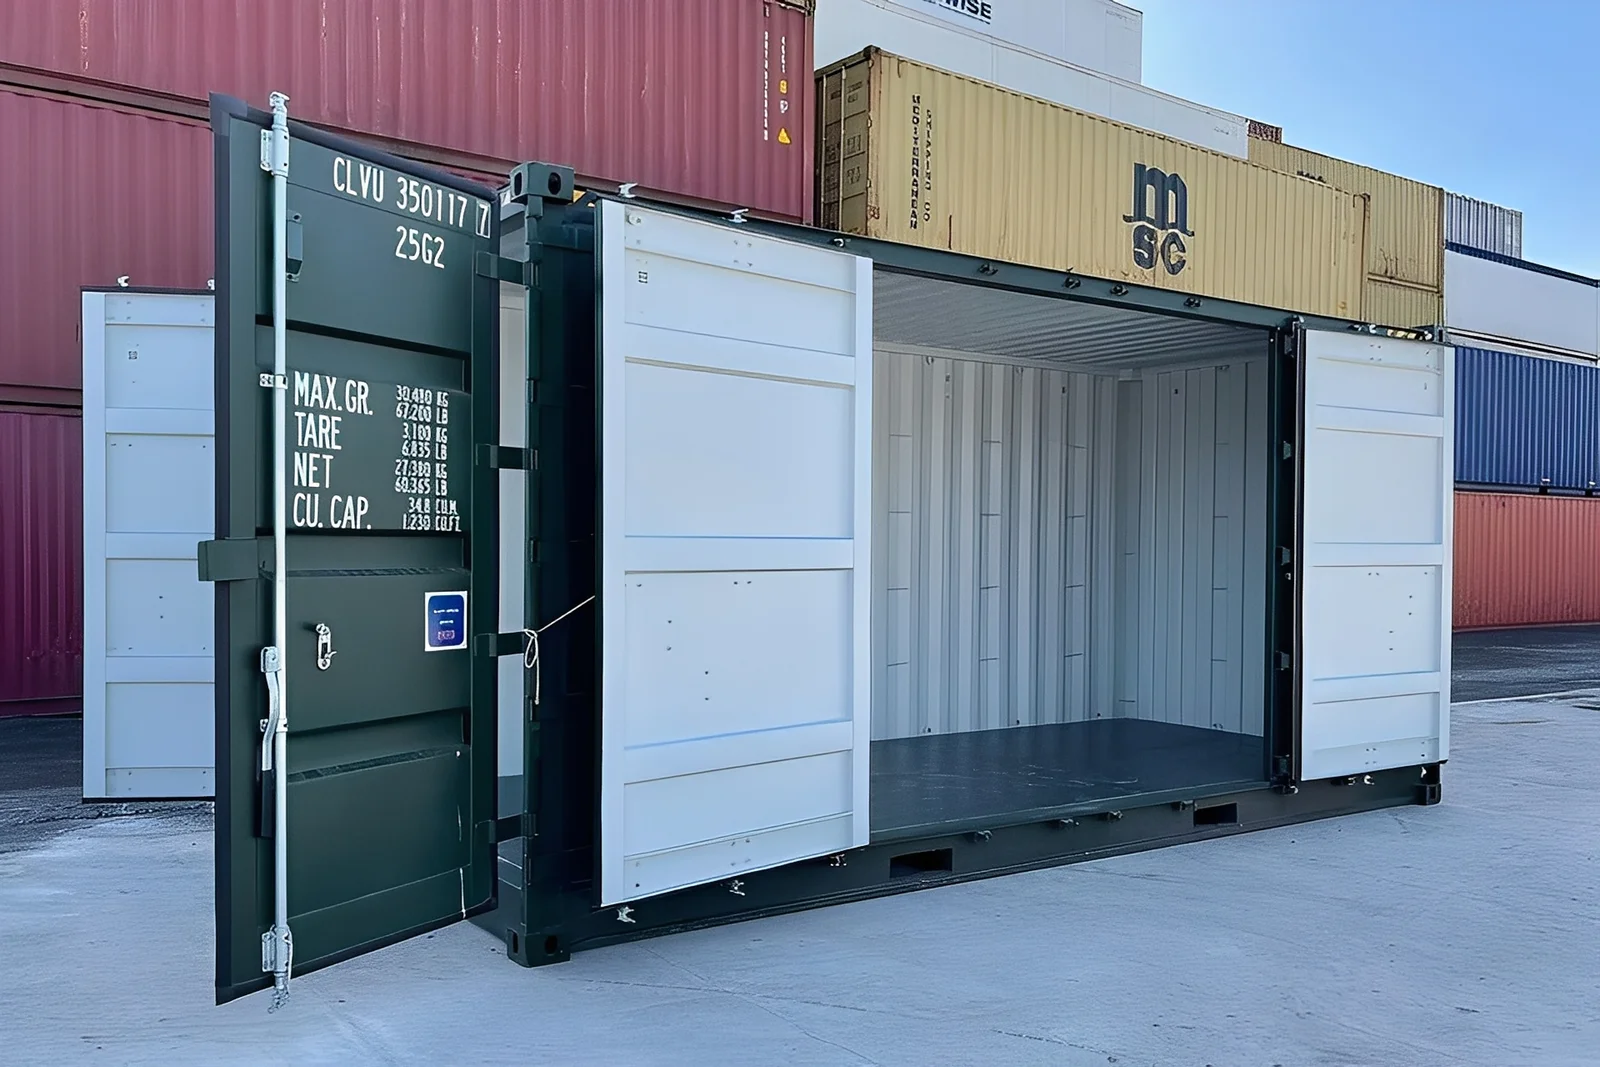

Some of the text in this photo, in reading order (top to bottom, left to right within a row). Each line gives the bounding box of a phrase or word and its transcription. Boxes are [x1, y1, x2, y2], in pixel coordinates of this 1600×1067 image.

[333, 156, 384, 203] CLVU
[396, 176, 467, 228] 350117
[395, 225, 445, 269] 25G2
[294, 370, 342, 411] MAX.
[345, 379, 373, 416] GR.
[294, 411, 342, 450] TARE
[436, 407, 448, 424] LB
[293, 451, 334, 489] NET
[435, 443, 447, 460] LB
[435, 479, 447, 496] LB
[292, 492, 323, 528] CU.
[330, 495, 372, 530] CAP.
